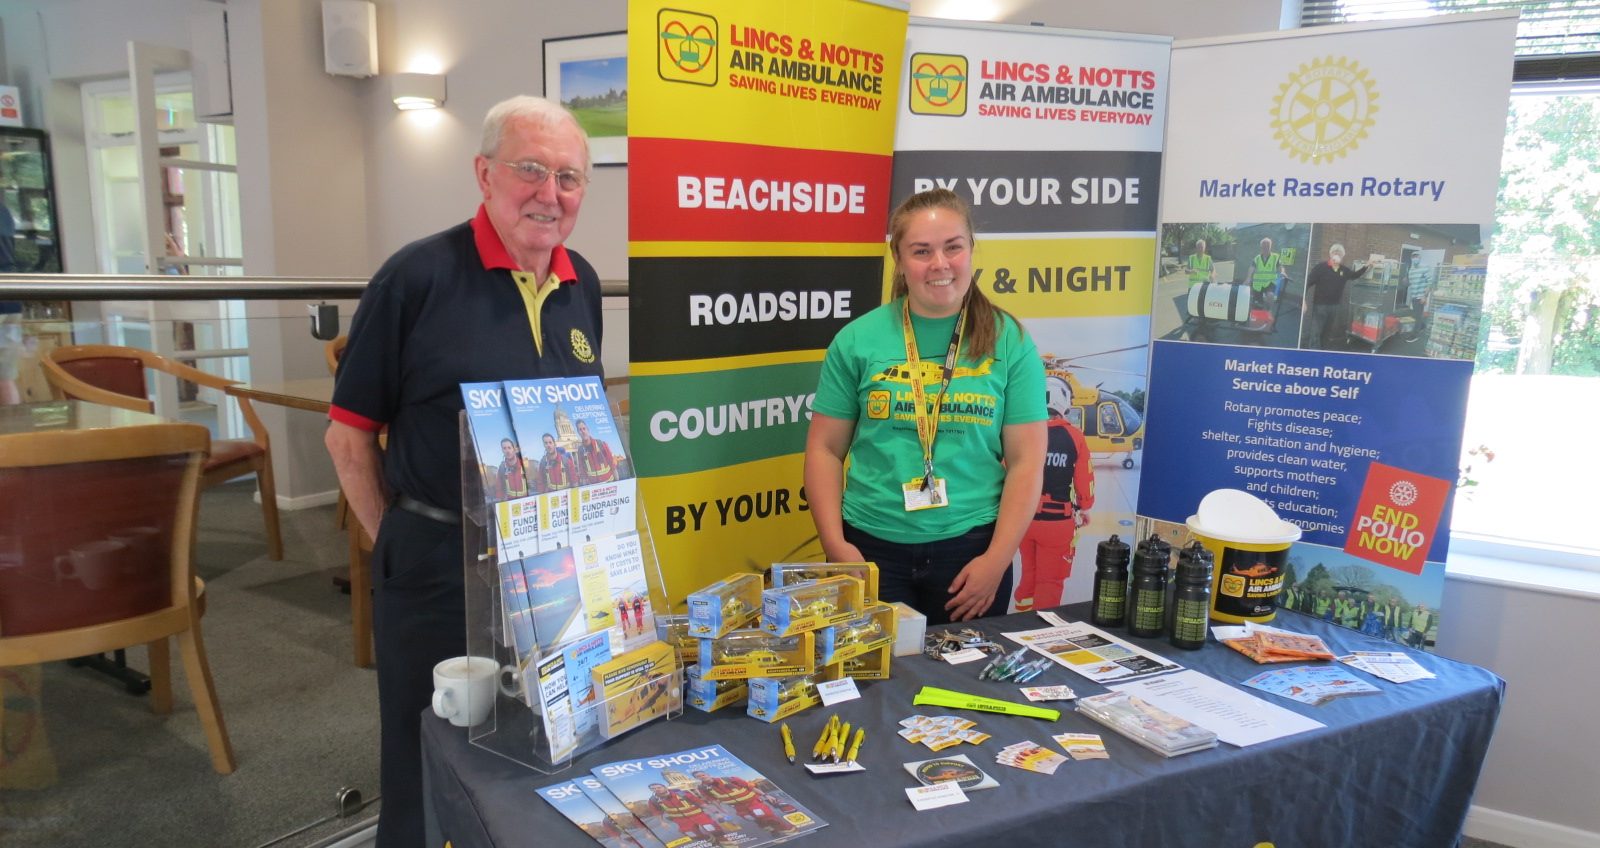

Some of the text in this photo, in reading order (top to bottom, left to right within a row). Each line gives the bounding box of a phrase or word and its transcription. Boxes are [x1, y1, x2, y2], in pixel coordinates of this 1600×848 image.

[730, 24, 884, 74] LINCS & NOTTS
[729, 50, 883, 95] AIR AMBULANCE
[981, 60, 1155, 90] LINCS & NOTTS
[729, 74, 881, 111] SAVING LIVES EVERYDAY
[979, 82, 1155, 110] AIR AMBULANCE
[978, 103, 1153, 126] SAVING LIVES EVERYDAY
[677, 175, 866, 214] BEACHSIDE
[966, 177, 1063, 207] YOUR
[1070, 177, 1140, 206] SIDE
[1200, 176, 1446, 202] Market Rasen Rotary
[992, 267, 1017, 294] &
[1028, 265, 1132, 294] NIGHT
[689, 290, 852, 327] ROADSIDE
[1224, 358, 1373, 385] Market Rasen Rotary
[468, 388, 501, 410] SKY
[511, 383, 600, 406] SKY SHOUT
[1232, 378, 1360, 400] Service above Self
[574, 404, 605, 413] DELIVERING
[894, 401, 995, 418] AIR BULANCE
[954, 393, 997, 408] NOTTS
[1224, 400, 1363, 425] Rotary promotes peace;
[1247, 418, 1334, 438] Fights disease;
[1202, 429, 1381, 461] shelter, sanitation and hygiene;
[1227, 448, 1348, 472] provides clean water,
[1234, 464, 1337, 486] supports mothers
[1246, 479, 1320, 501] and children;
[582, 496, 631, 512] FUNDRAISING
[666, 501, 708, 536] BY
[715, 487, 791, 527] YOUR
[1277, 500, 1339, 519] education;
[582, 510, 605, 522] GUIDE
[1371, 504, 1419, 530] END
[513, 524, 538, 537] GUIDE
[1356, 515, 1425, 549] POLIO
[605, 548, 638, 562] KNOW WHAT
[1358, 531, 1417, 561] NOW
[610, 569, 623, 577] SAVE
[615, 558, 632, 568] COSTS
[1247, 585, 1263, 593] AIR
[1249, 578, 1274, 586] LINCS
[577, 656, 588, 667] 24/7
[544, 682, 557, 692] HOW
[615, 671, 631, 681] SUPPORT
[545, 688, 556, 698] CAN
[601, 747, 721, 778] SKY SHOUT
[546, 783, 582, 800] SK
